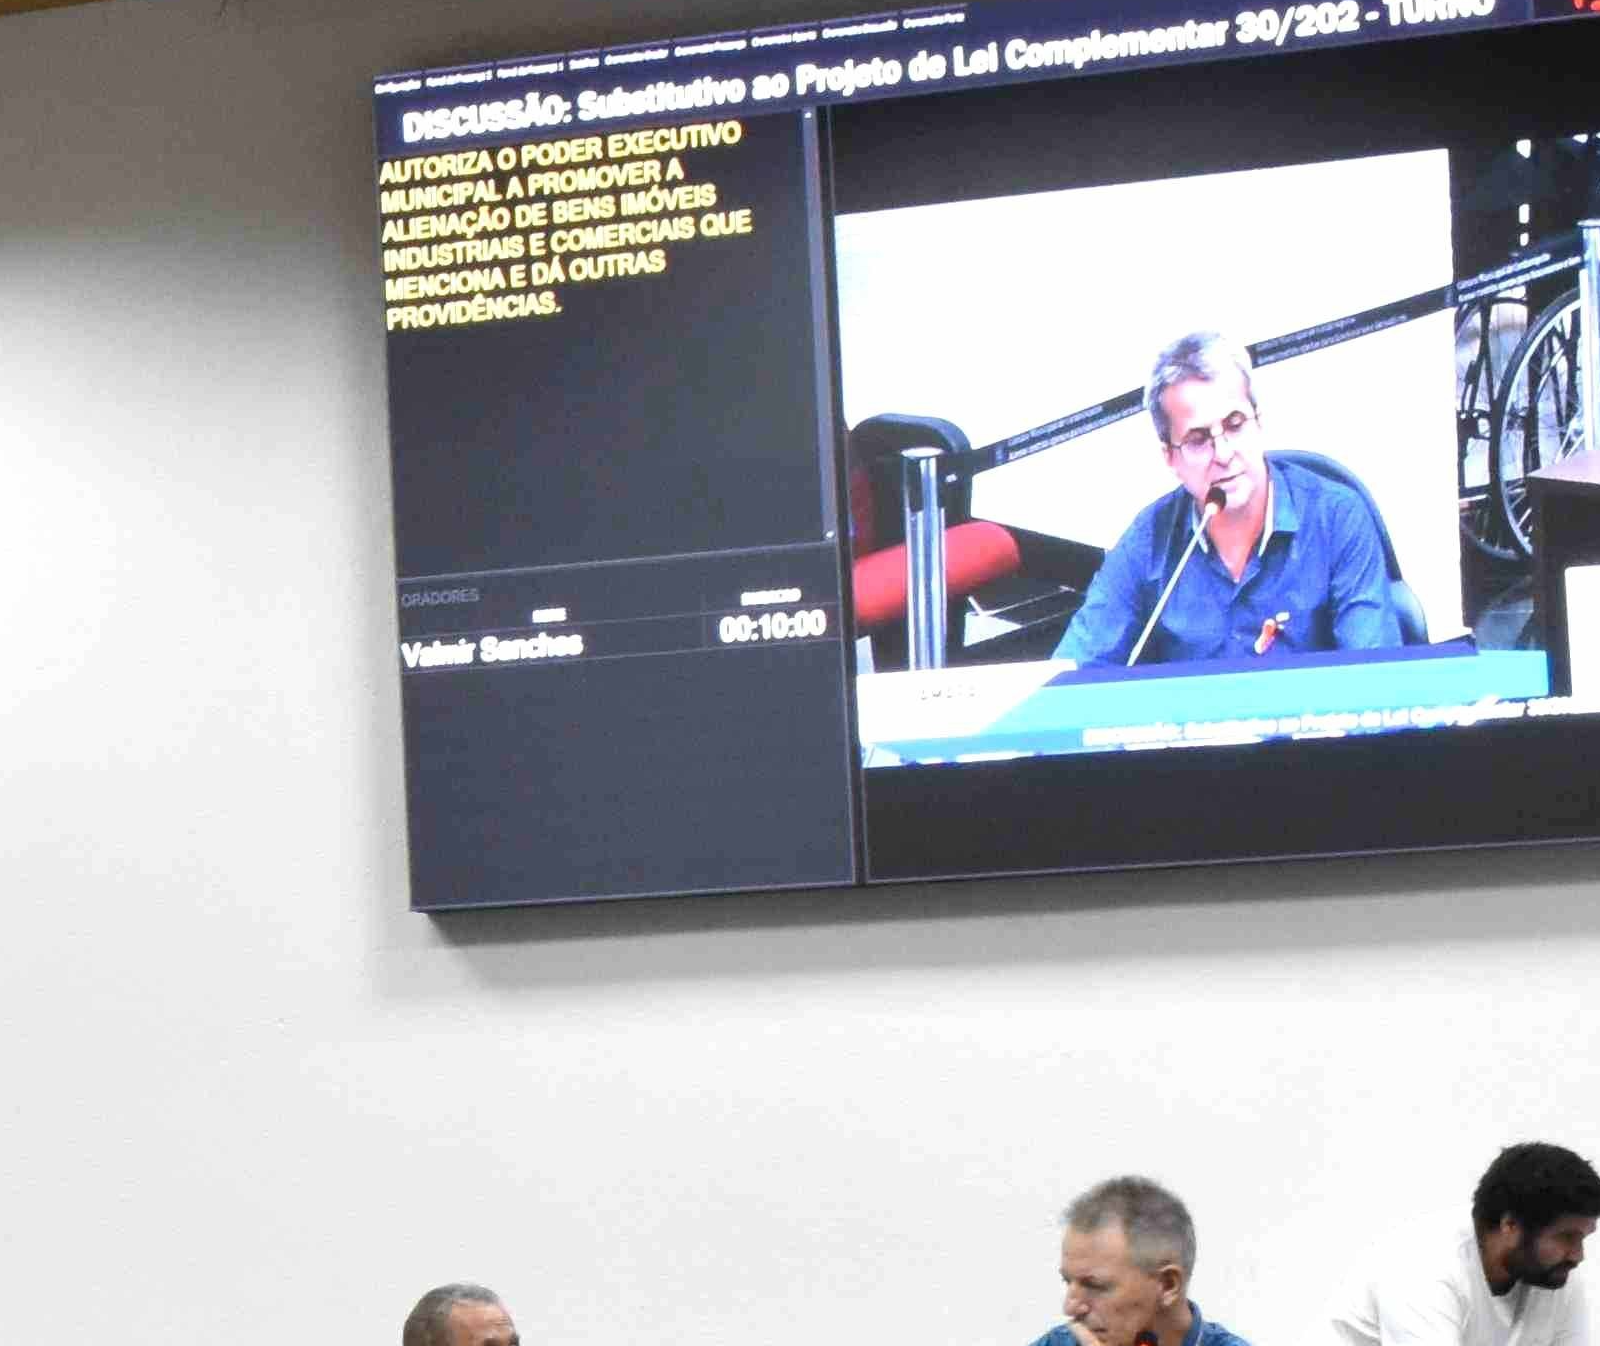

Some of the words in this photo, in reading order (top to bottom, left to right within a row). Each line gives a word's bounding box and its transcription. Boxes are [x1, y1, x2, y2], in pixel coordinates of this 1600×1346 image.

[402, 92, 572, 143] DISCUSSÃO:
[577, 76, 747, 121] Substitutivo
[752, 73, 790, 100] ao
[796, 57, 902, 96] Projeto
[908, 50, 947, 82] de
[953, 42, 998, 77] Lei
[1005, 20, 1229, 70] Complementar
[1235, 0, 1360, 44] 30/202
[379, 150, 493, 184] AUTORIZA
[497, 147, 516, 170] O
[521, 137, 603, 168] PODER
[608, 121, 741, 158] EXECUTIVO
[381, 179, 502, 213] MUNICIPAL
[506, 176, 524, 199] A
[528, 160, 661, 197] PROMOVER
[666, 158, 684, 181] A
[382, 206, 511, 243] ALIENAÇÃO
[515, 202, 548, 228] DE
[552, 195, 616, 223] BENS
[621, 184, 716, 216] IMÓVEIS
[384, 235, 525, 272] INDUSTRIAIS
[529, 233, 546, 256] E
[550, 216, 696, 256] COMERCIAIS
[700, 209, 752, 236] QUE
[386, 267, 506, 301] MENCIONA
[510, 264, 527, 288] E
[532, 256, 565, 285] DÁ
[569, 250, 666, 281] OUTRAS
[387, 291, 561, 330] PROVIDÊNCIAS.
[401, 638, 476, 668] Valmir
[719, 609, 826, 643] 00:10:00
